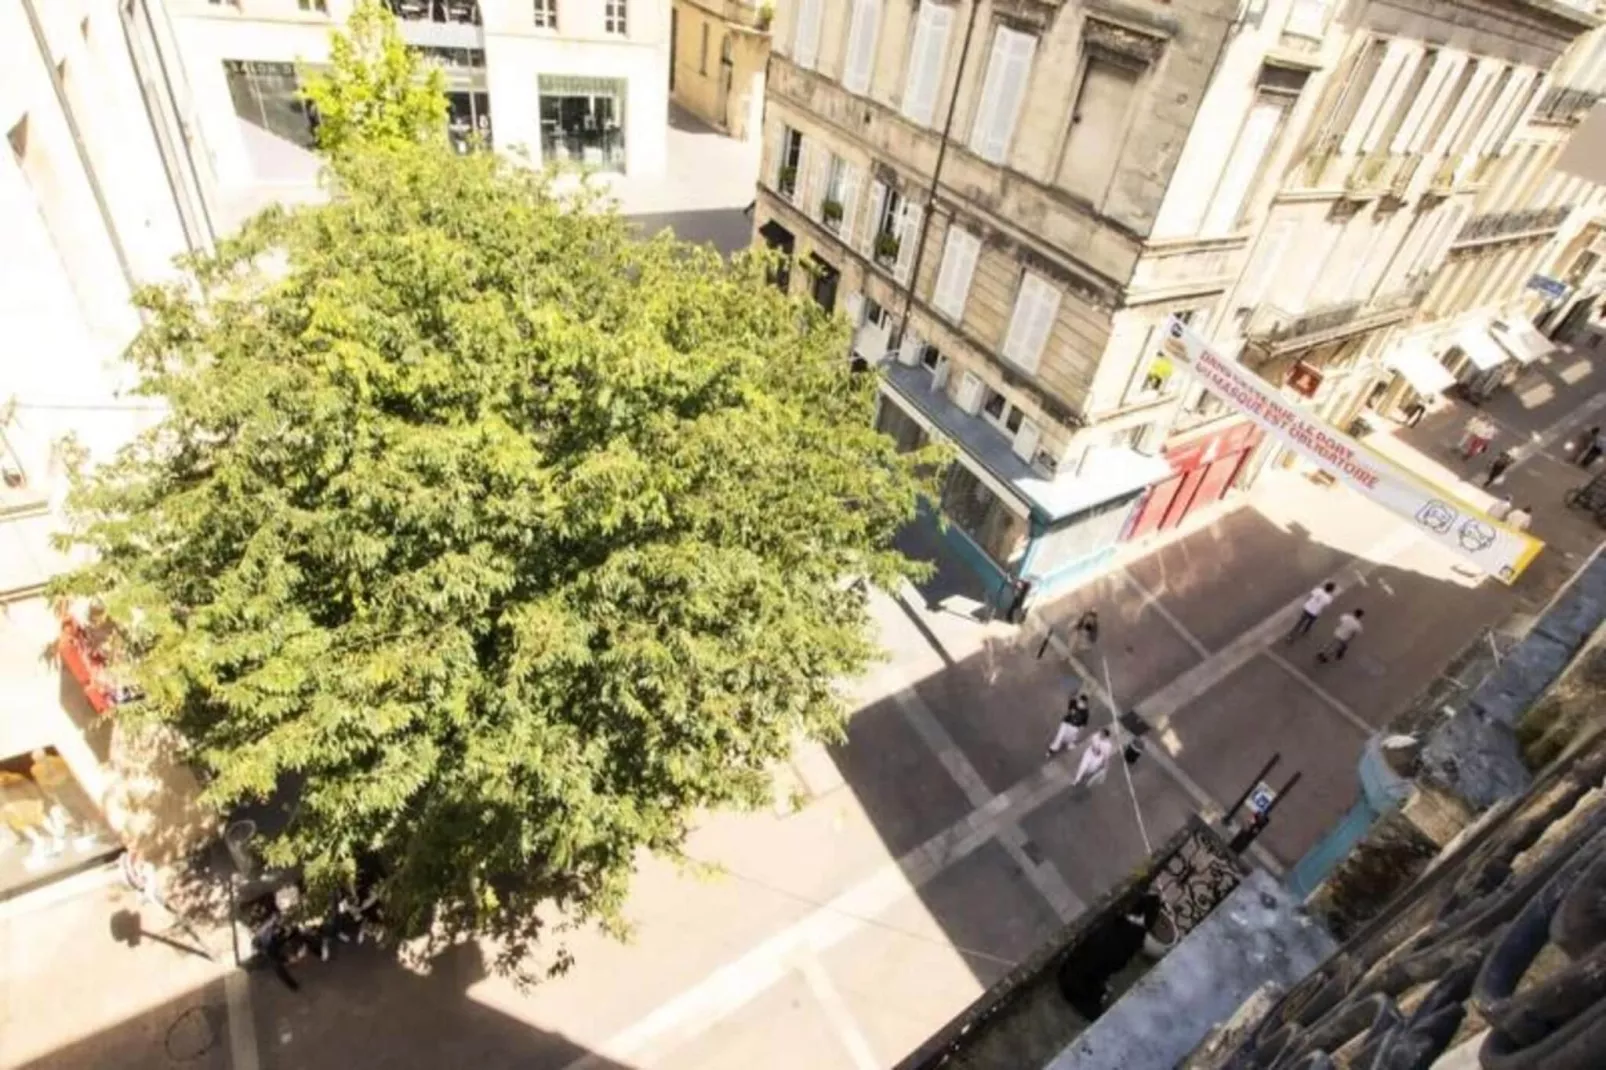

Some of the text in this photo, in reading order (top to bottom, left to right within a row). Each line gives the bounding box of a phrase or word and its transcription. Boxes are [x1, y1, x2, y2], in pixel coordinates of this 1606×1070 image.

[1211, 373, 1262, 415] MASQUE
[1262, 407, 1289, 429] EST
[1288, 425, 1380, 489] OBLIGATOIRE
